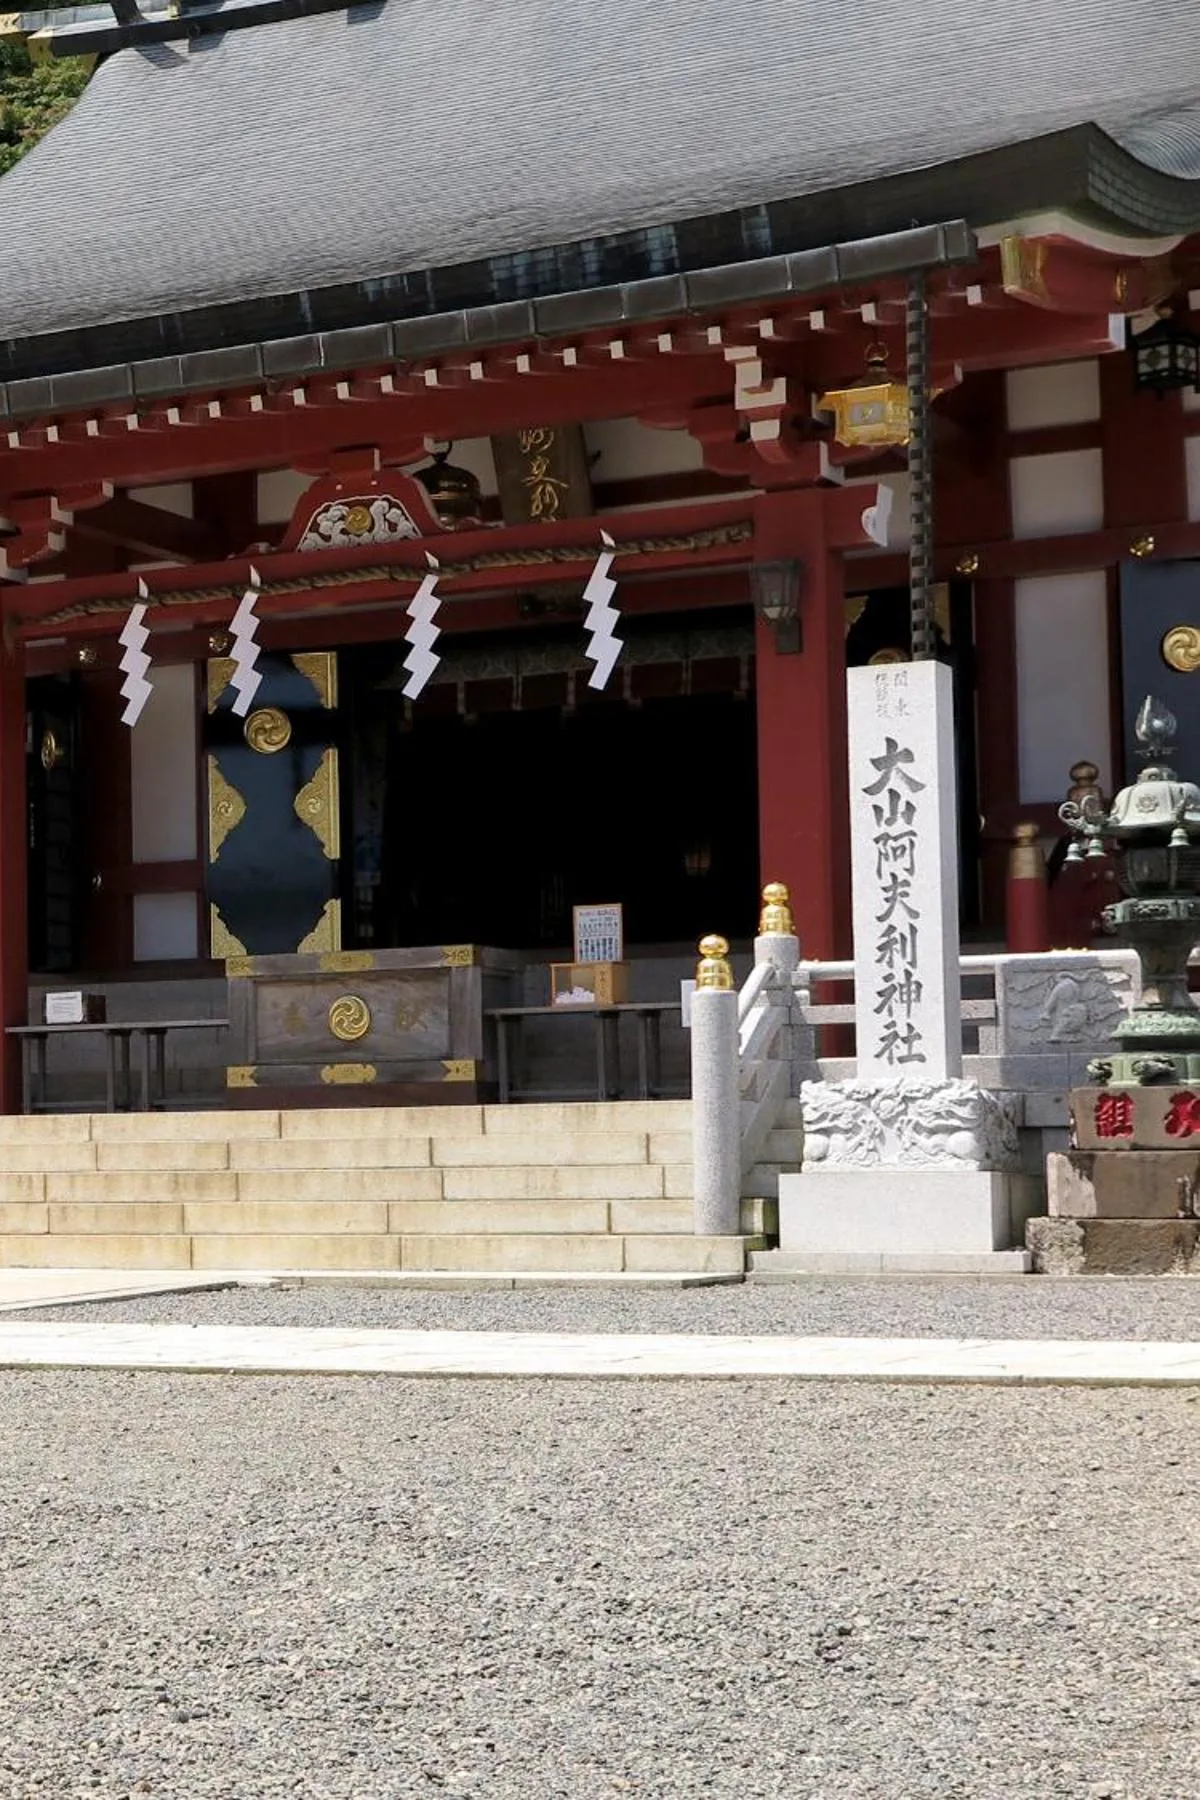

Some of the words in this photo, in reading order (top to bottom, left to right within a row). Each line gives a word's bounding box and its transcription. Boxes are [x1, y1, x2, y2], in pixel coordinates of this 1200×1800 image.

[862, 736, 927, 1066] 大山阿夫利神社
